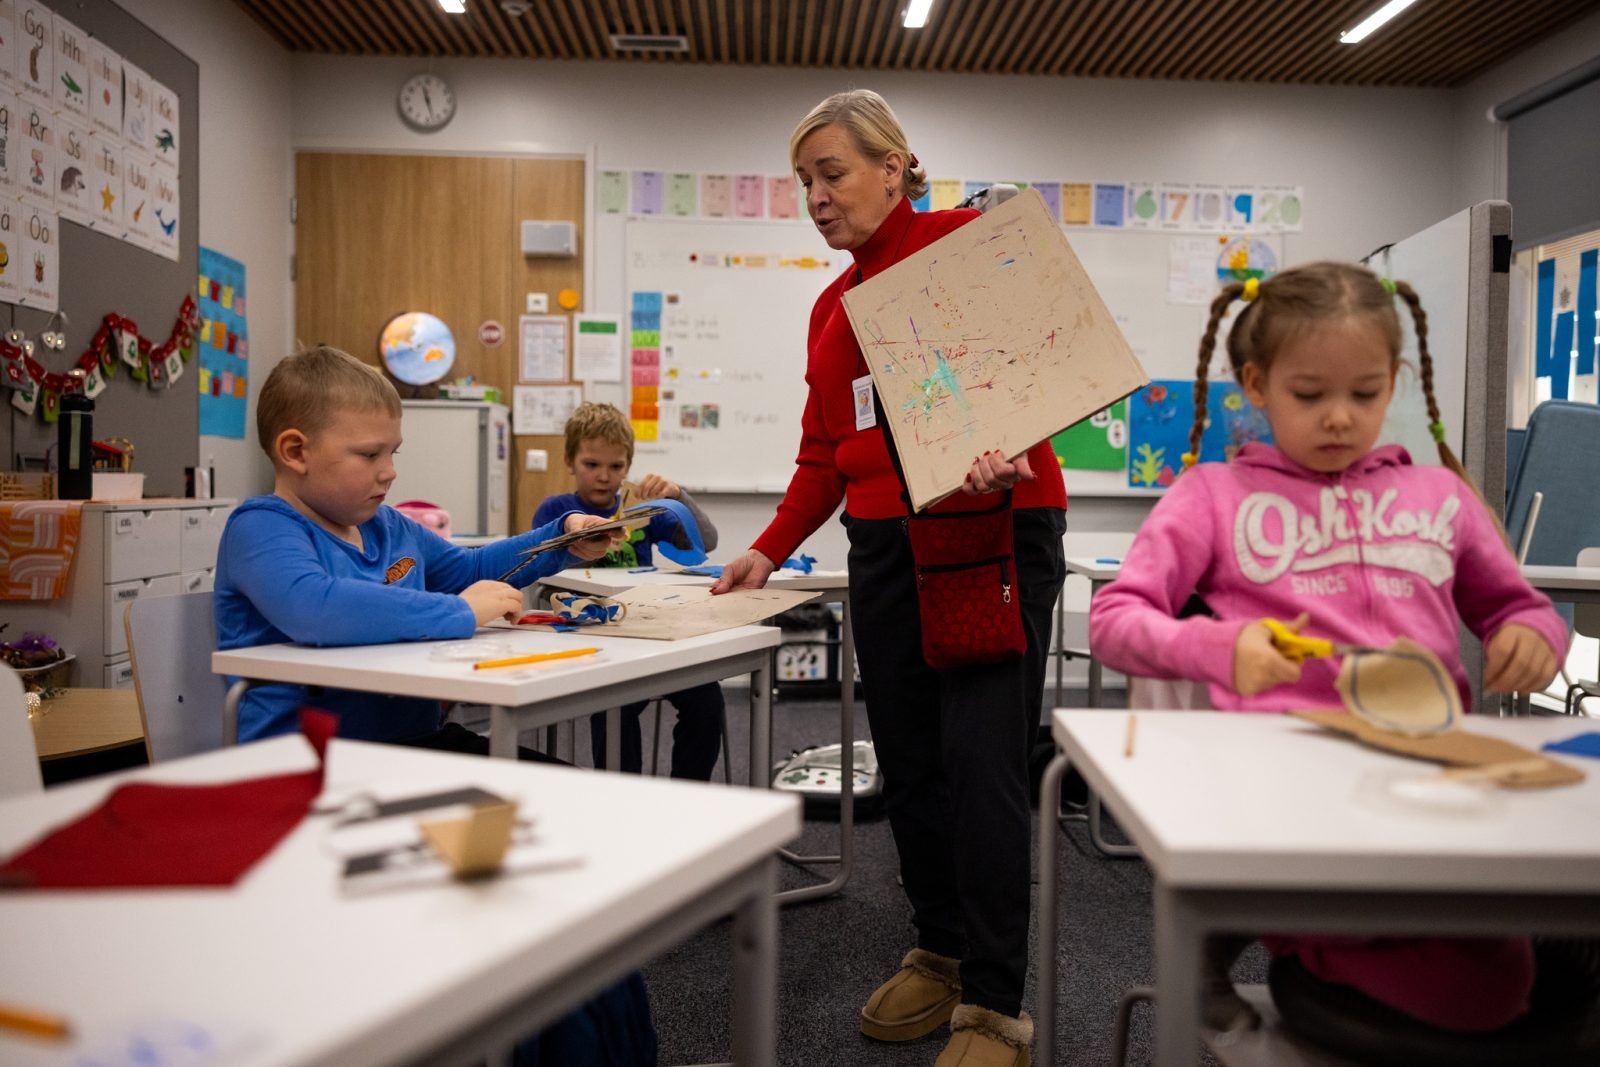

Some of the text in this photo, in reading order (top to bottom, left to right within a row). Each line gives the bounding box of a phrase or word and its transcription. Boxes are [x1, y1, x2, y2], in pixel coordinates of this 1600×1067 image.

[24, 9, 44, 49] Gg
[62, 31, 81, 65] Hh
[0, 107, 9, 138] q
[29, 112, 48, 142] Rr
[66, 131, 81, 160] Ss
[102, 147, 115, 177] Tt
[1, 205, 10, 232] ä
[1292, 573, 1348, 596] SINCE
